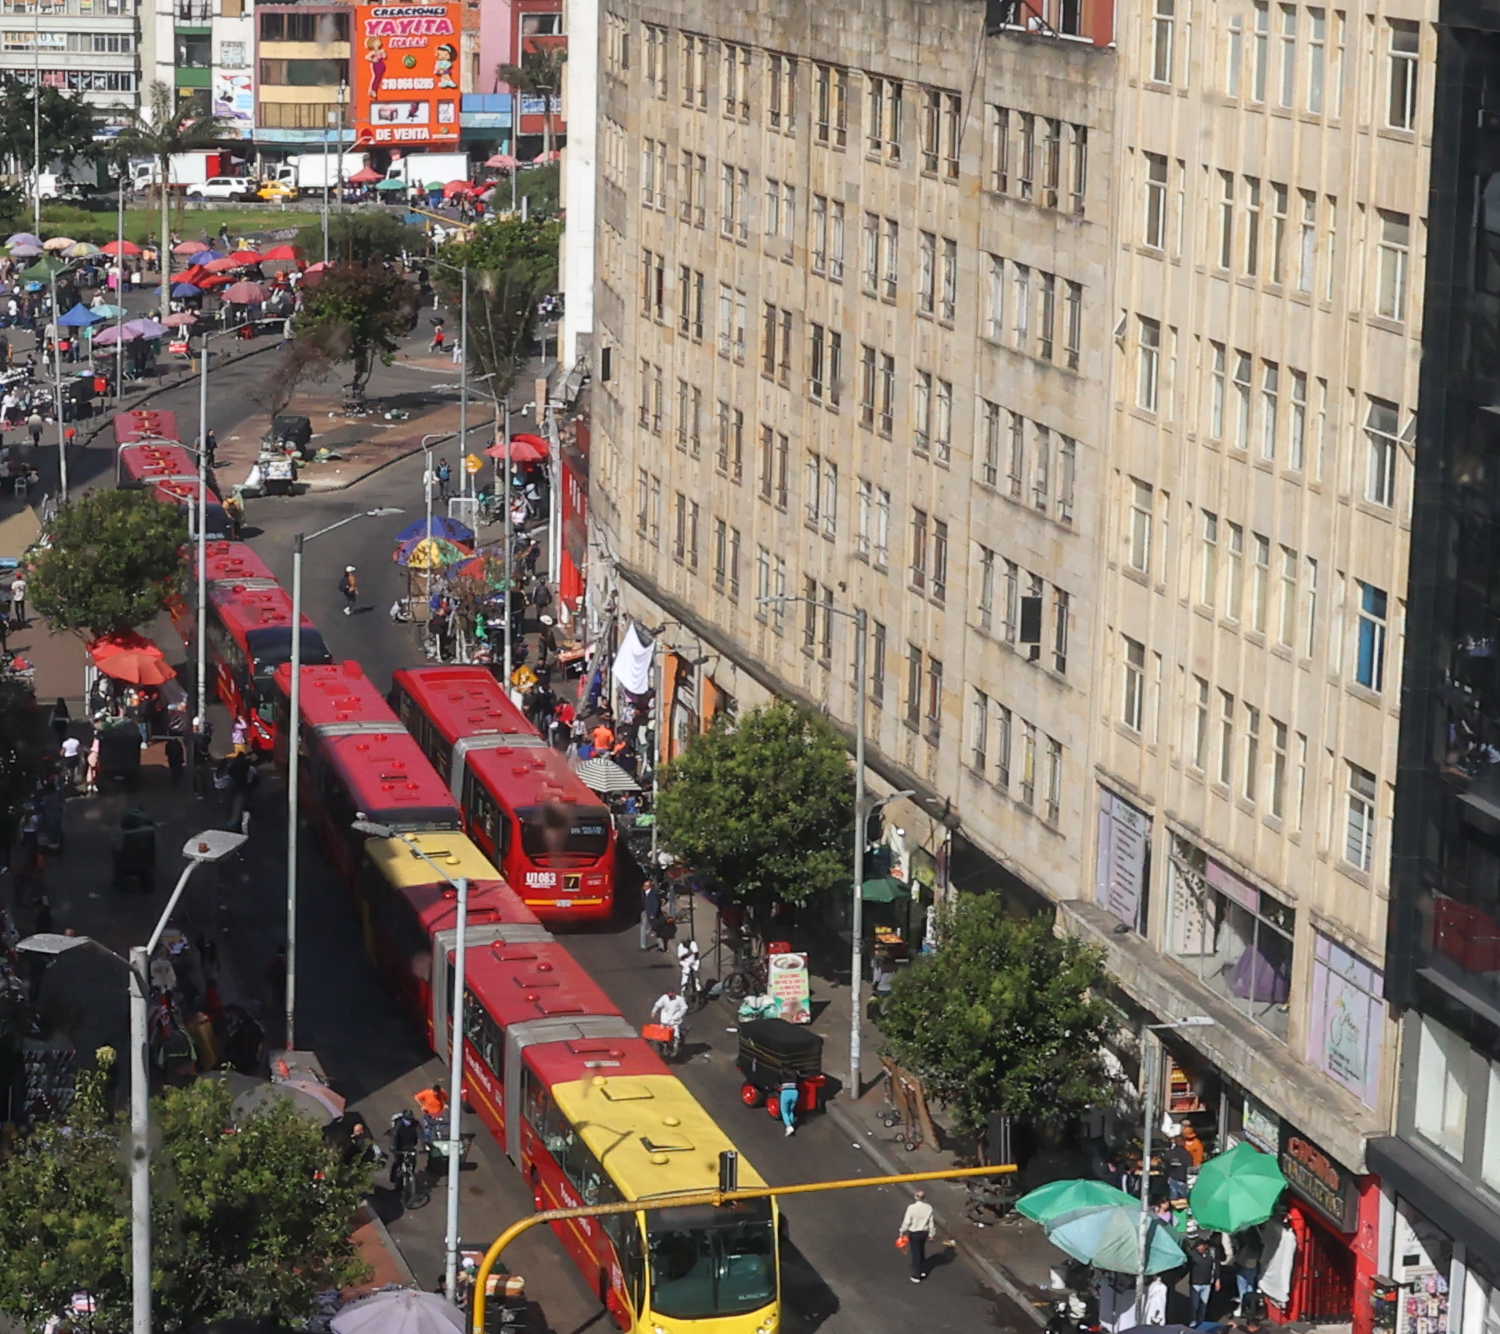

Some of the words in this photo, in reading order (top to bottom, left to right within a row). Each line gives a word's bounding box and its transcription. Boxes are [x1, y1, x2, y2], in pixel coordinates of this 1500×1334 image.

[373, 7, 446, 16] CREACIONES
[365, 18, 453, 35] YAYITA
[376, 129, 391, 140] DE
[394, 128, 430, 140] VENTA
[526, 872, 557, 884] U1083
